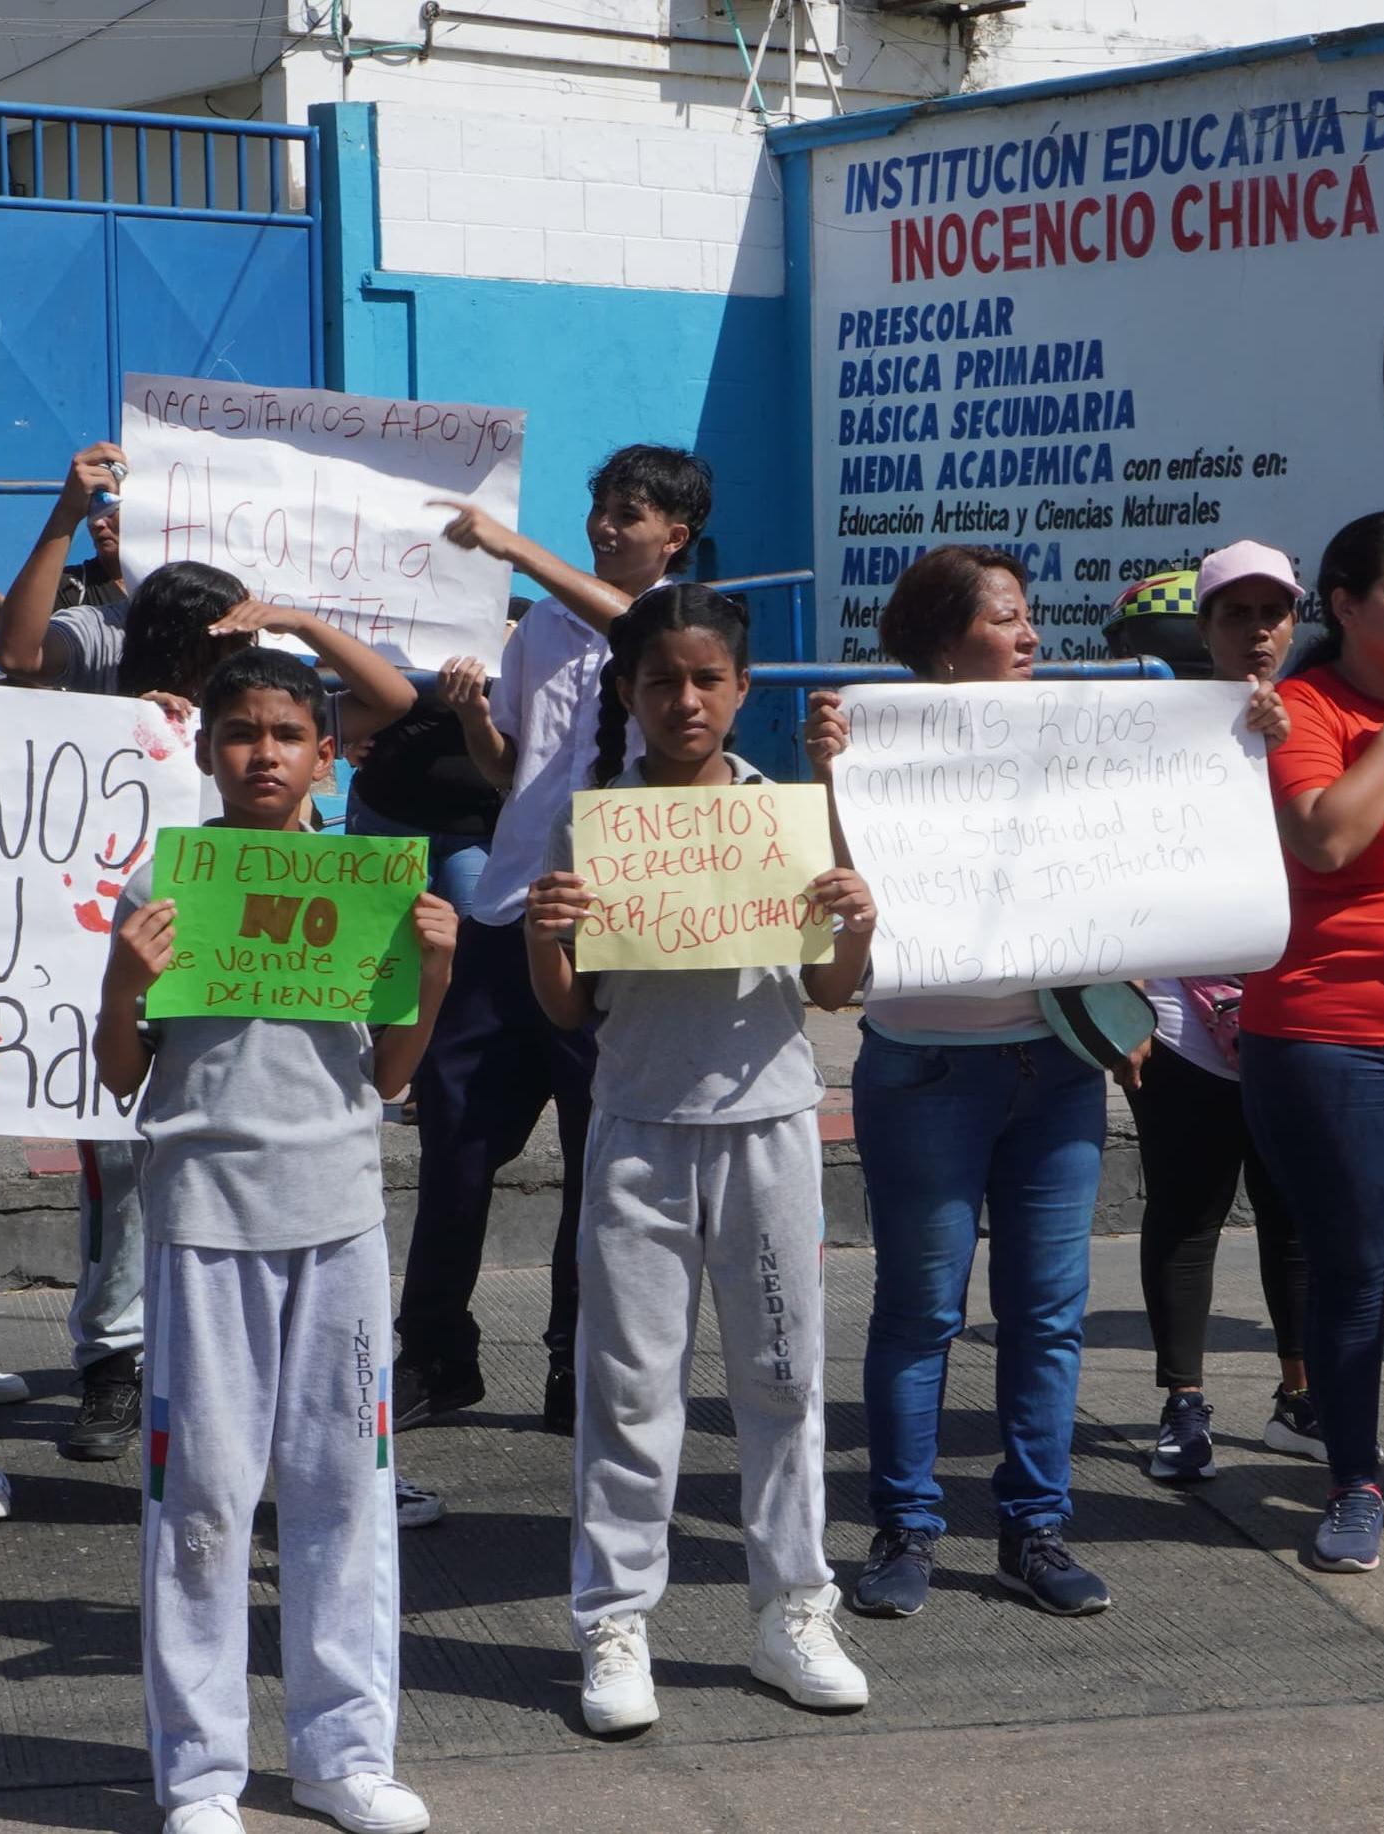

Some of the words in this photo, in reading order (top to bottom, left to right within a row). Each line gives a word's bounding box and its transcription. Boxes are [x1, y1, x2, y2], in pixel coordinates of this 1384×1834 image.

[844, 120, 1090, 215] INSTITUCIÓN
[1102, 96, 1347, 183] EDUCATIVA
[890, 189, 1156, 284] INOCENCIO
[1171, 154, 1379, 253] CHINCÁ
[837, 296, 1015, 351] PREESCOLAR
[838, 348, 942, 399] BÁSICA
[953, 338, 1105, 390] PRIMARIA
[838, 398, 940, 446] BÁSICA
[949, 388, 1136, 441] SECUNDARIA
[839, 453, 924, 496] MEDIA
[935, 442, 1114, 492] ACADEMICA
[1122, 457, 1162, 482] con
[1168, 447, 1246, 481] enfasis
[1252, 453, 1288, 479] en:
[837, 500, 924, 537] Educación
[930, 499, 1011, 534] Artística
[1013, 506, 1028, 537] y
[1034, 498, 1114, 530] Ciencias
[1120, 491, 1221, 528] Naturales
[1073, 557, 1111, 582] con
[920, 697, 1011, 757] MAS
[580, 794, 778, 844] TENEMOS
[863, 818, 949, 862] MAS
[1151, 802, 1204, 835] en
[171, 834, 216, 885] LA
[235, 840, 428, 887] EDUCACIÓN
[586, 843, 742, 887] DERECHO
[759, 841, 790, 870] A
[238, 892, 338, 949] NO
[584, 894, 645, 937] SER
[357, 957, 401, 981] SE
[758, 1232, 794, 1381] INEDICH
[353, 1318, 374, 1438] INEDICH
